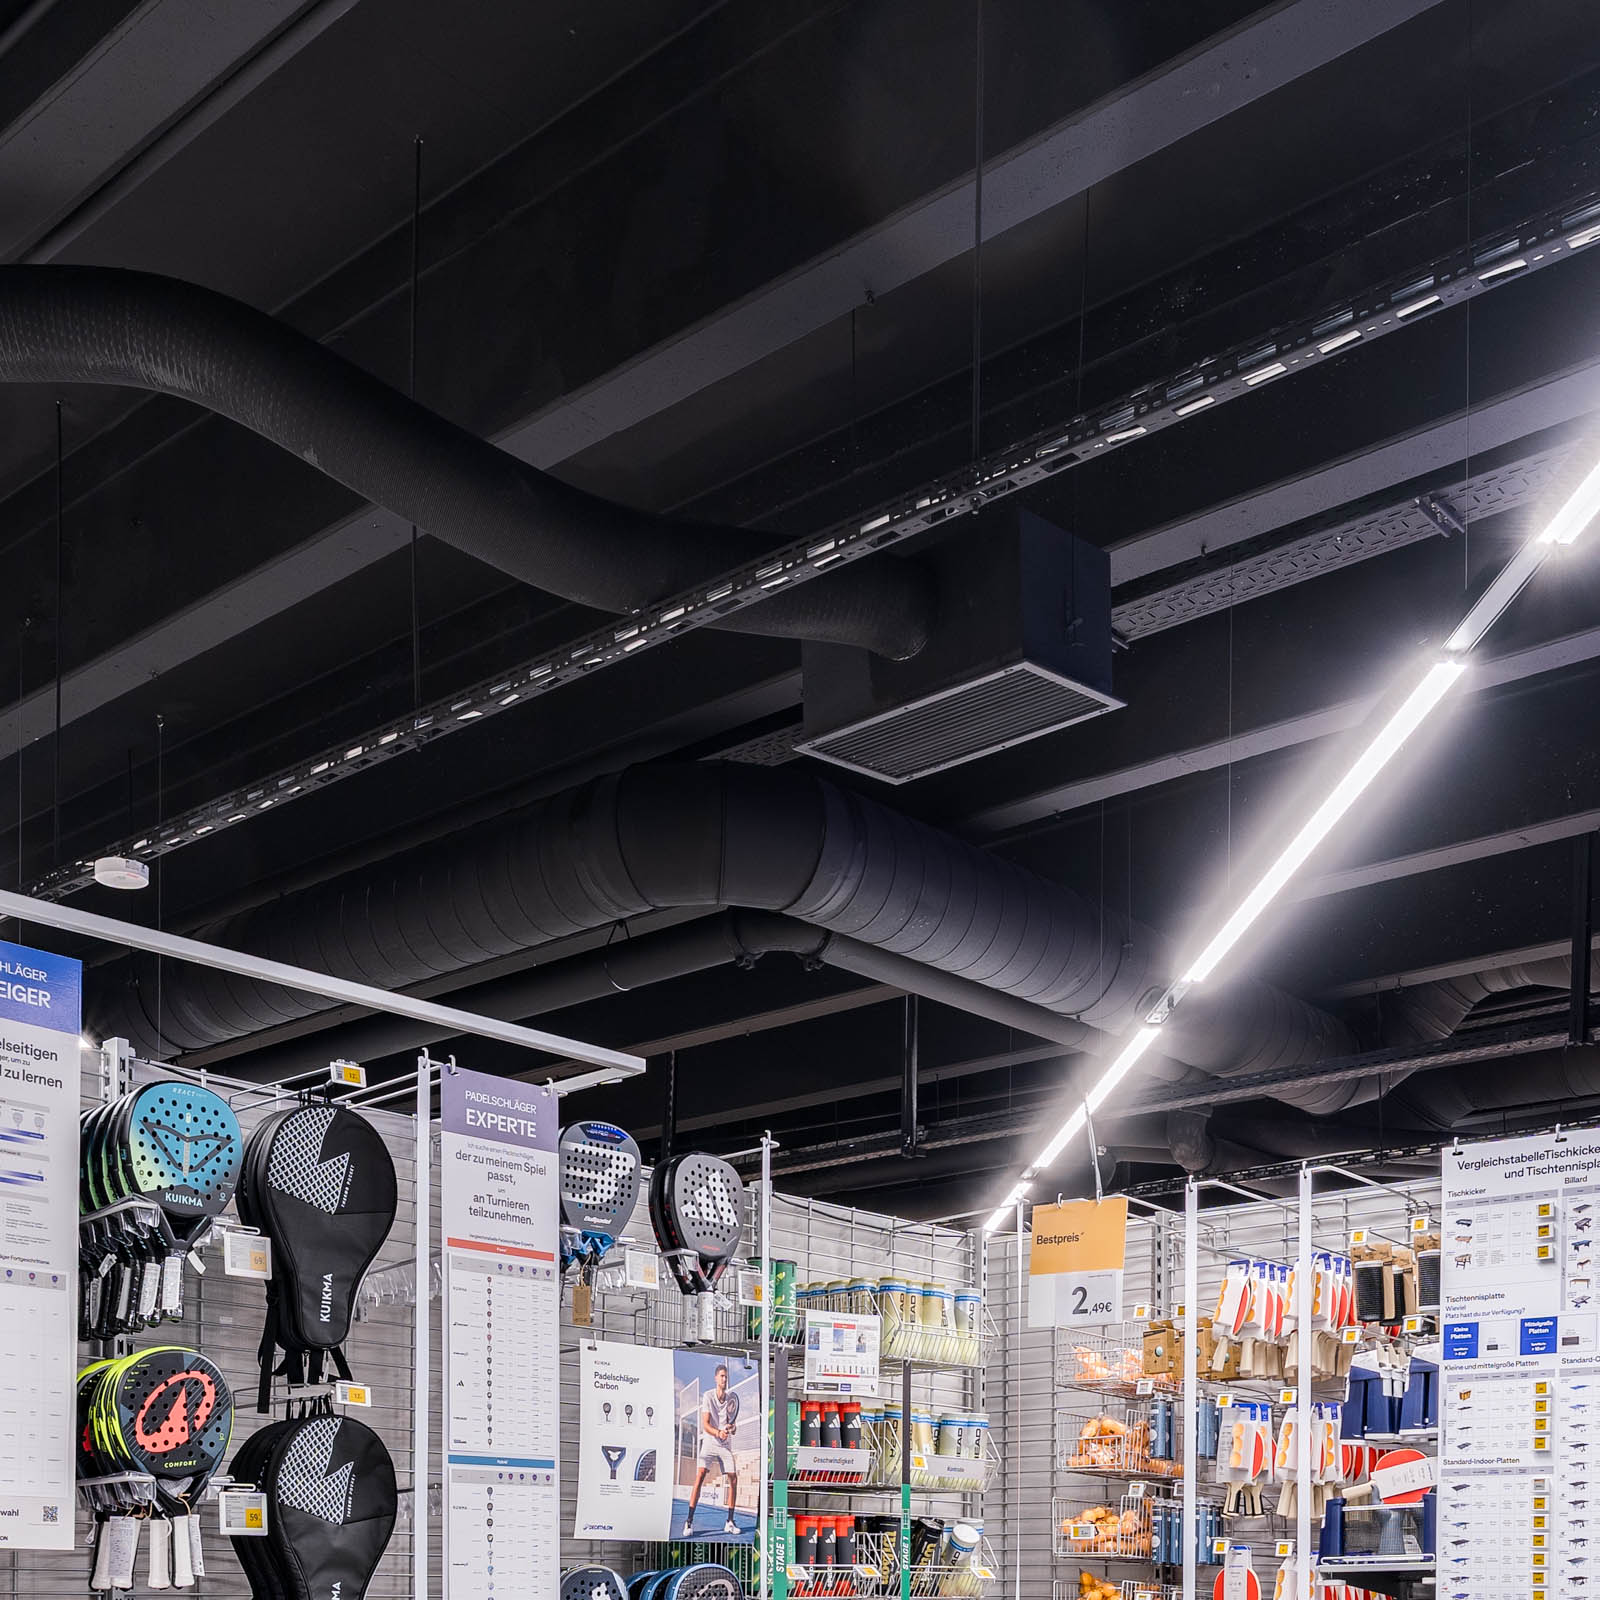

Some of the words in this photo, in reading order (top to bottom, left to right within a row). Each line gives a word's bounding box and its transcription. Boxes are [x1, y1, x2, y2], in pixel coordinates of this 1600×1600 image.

[5, 1068, 19, 1080] zu
[22, 1069, 62, 1088] lernen
[465, 1090, 537, 1114] PADELSCHLÄGER
[466, 1108, 537, 1138] EXPERTE
[456, 1150, 471, 1161] der
[473, 1154, 484, 1163] zu
[486, 1156, 522, 1171] meinem
[524, 1162, 546, 1176] Spiel
[488, 1171, 516, 1185] passt,
[1504, 1168, 1524, 1179] und
[1565, 1175, 1587, 1184] Billard
[165, 1192, 204, 1208] KUIKMA
[1448, 1188, 1486, 1198] Tischkicker
[473, 1194, 485, 1203] an
[487, 1194, 529, 1211] Turnieren
[469, 1206, 534, 1226] teilzunehmen.
[1036, 1232, 1080, 1246] Bestpreis
[320, 1273, 333, 1322] KUIKMA
[1071, 1286, 1113, 1316] 2,49€
[1445, 1292, 1505, 1303] Tischtennisplatte
[1477, 1360, 1514, 1369] mittelgroße
[594, 1372, 639, 1384] Padelschläger
[594, 1381, 618, 1391] Carbon
[164, 1460, 197, 1468] COMFORT
[1443, 1457, 1520, 1465] Standard-Indoor-Platten
[776, 1535, 785, 1544] 1
[776, 1546, 785, 1573] STAGE
